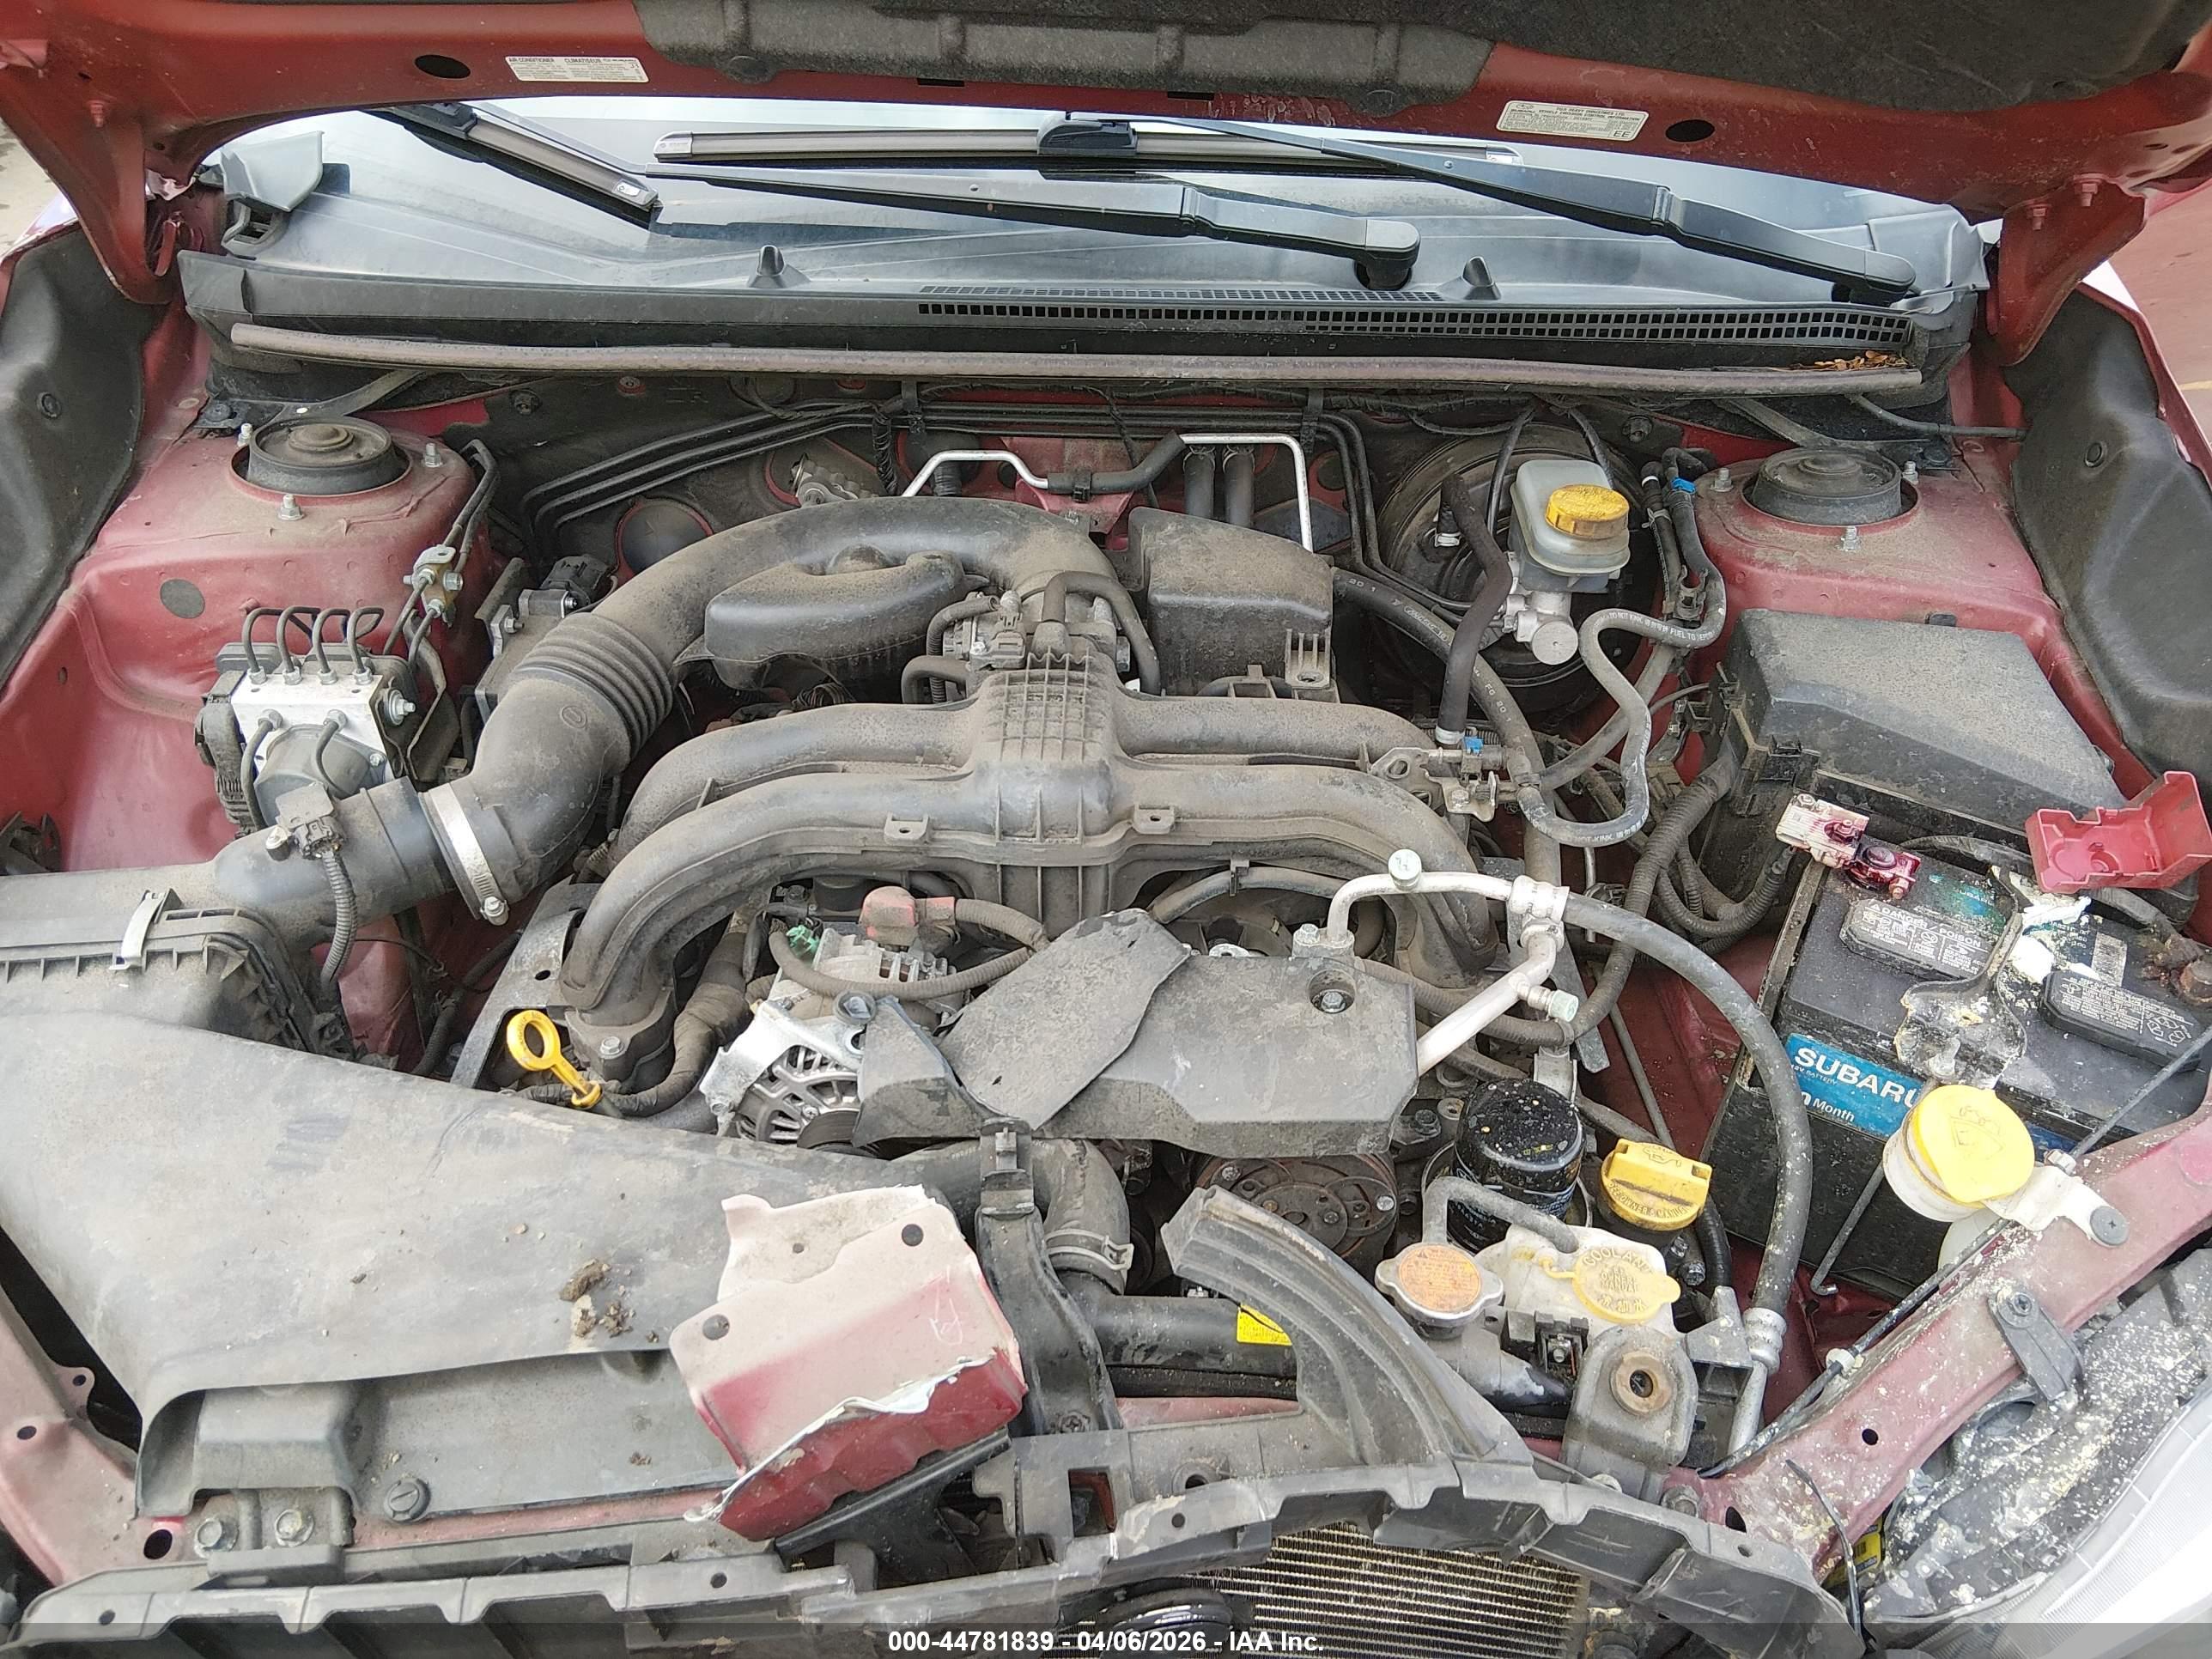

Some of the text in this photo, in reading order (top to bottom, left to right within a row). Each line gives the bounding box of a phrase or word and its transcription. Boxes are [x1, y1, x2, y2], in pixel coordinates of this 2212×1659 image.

[1670, 629, 1686, 639] FUEL
[1882, 906, 1928, 929] DANGER
[1939, 927, 1982, 948] POISON
[1807, 1069, 1838, 1085] BATTERY
[1813, 1097, 1855, 1121] Month
